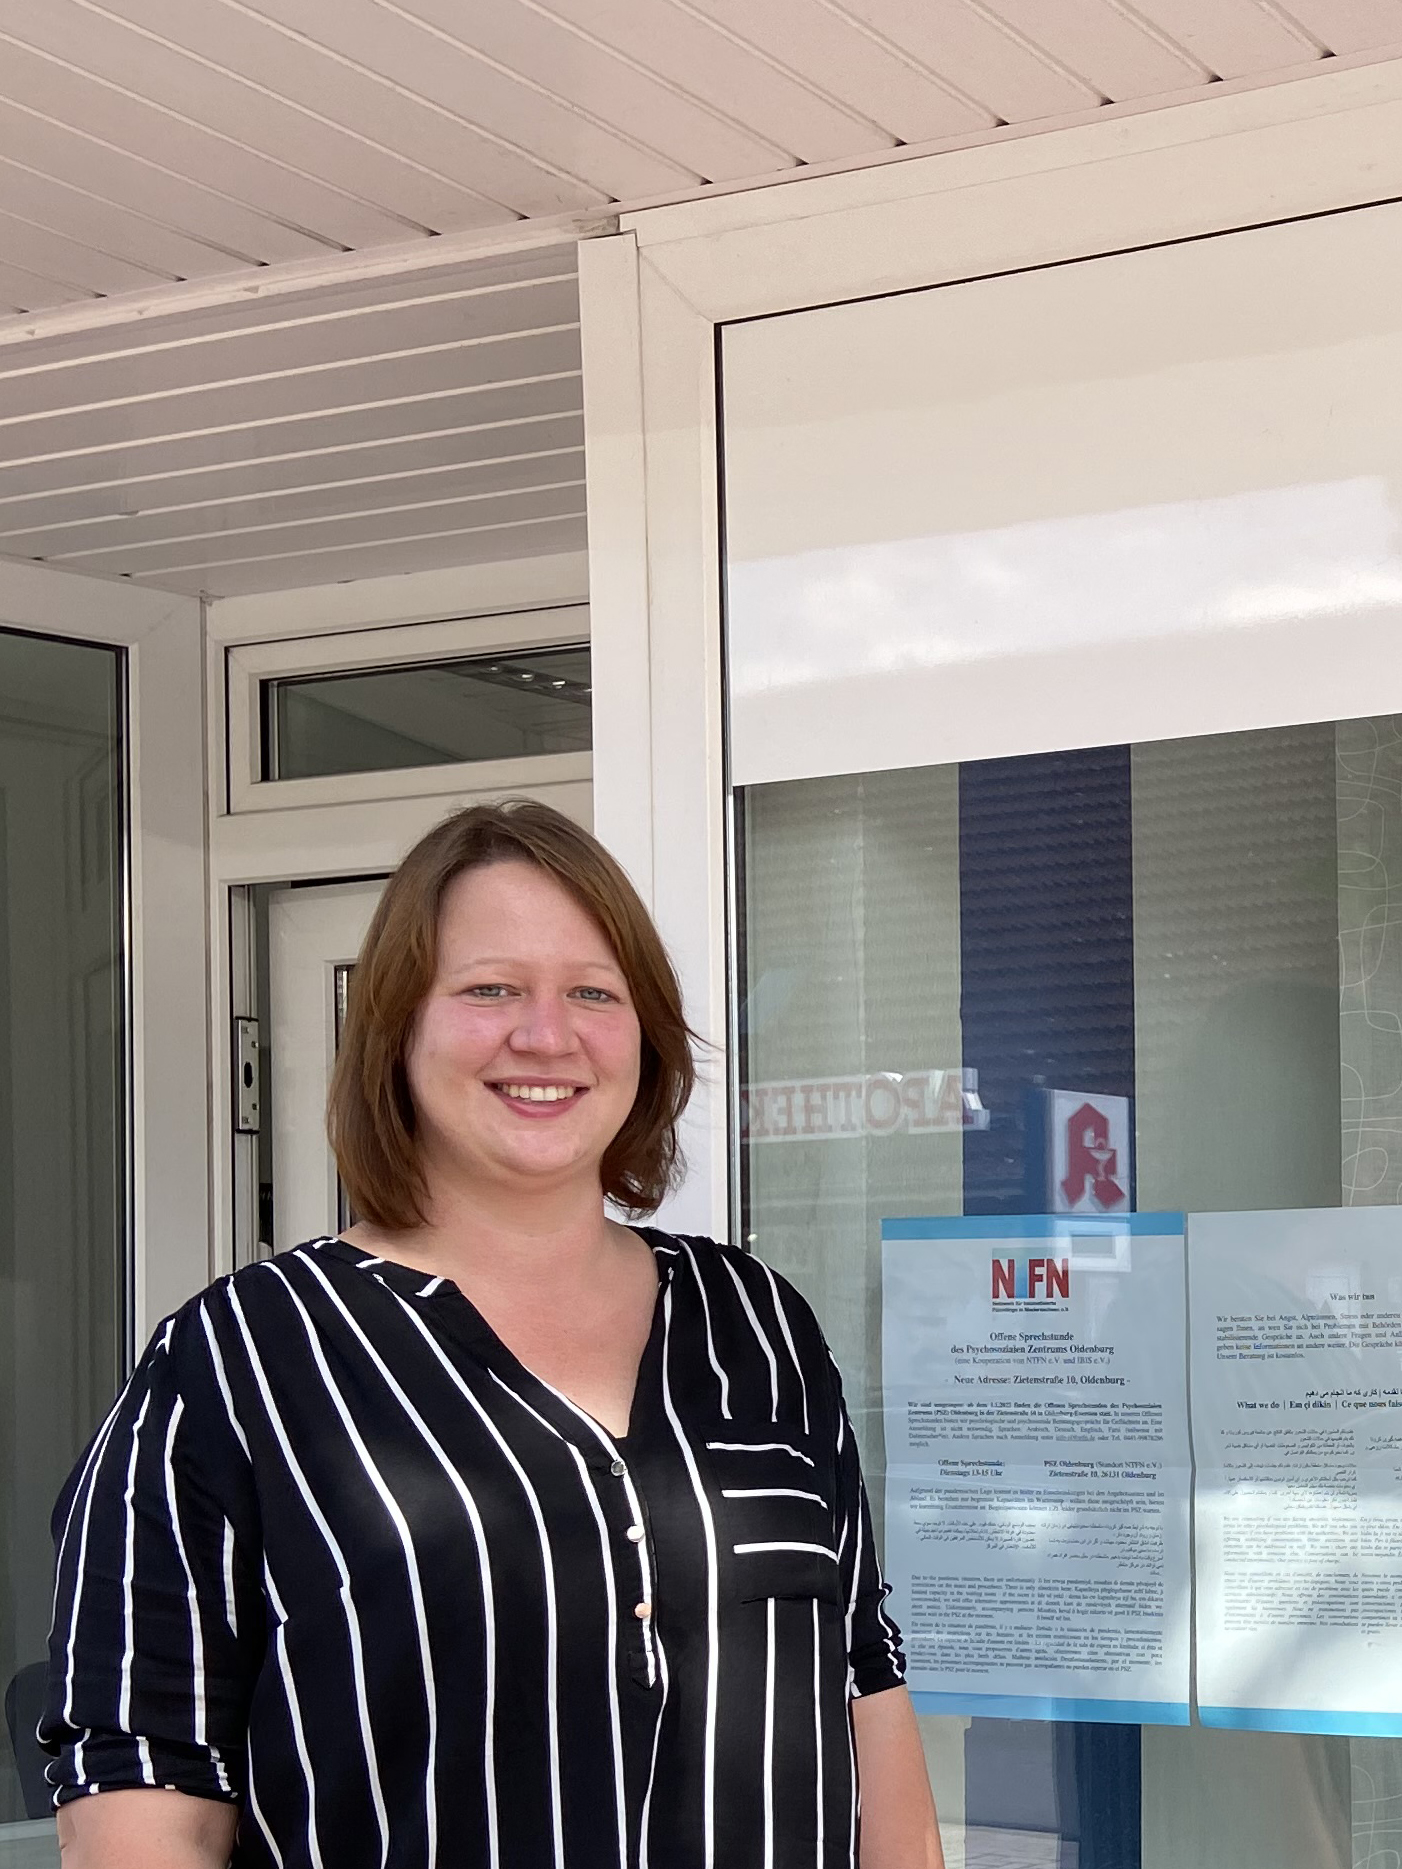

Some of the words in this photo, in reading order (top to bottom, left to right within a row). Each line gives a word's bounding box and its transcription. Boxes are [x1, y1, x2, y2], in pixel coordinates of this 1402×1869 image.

[990, 1332, 1017, 1341] Offene
[1019, 1332, 1074, 1343] Sprechstunde
[951, 1345, 964, 1353] des
[967, 1345, 1025, 1355] Psychosozialen
[1027, 1345, 1067, 1353] Zentrums
[1070, 1344, 1114, 1355] Oldenburg
[954, 1375, 974, 1384] Neue
[977, 1375, 1011, 1384] Adresse:
[1013, 1375, 1064, 1384] Zietenstraße
[1066, 1375, 1078, 1385] 10,
[1081, 1375, 1125, 1386] Oldenburg
[1237, 1400, 1256, 1409] What
[1270, 1401, 1280, 1409] do
[1290, 1400, 1302, 1409] Em
[1341, 1400, 1352, 1408] Ce
[1353, 1401, 1367, 1409] que
[1368, 1400, 1386, 1408] nous
[1059, 1460, 1094, 1469] Oldenburg
[1121, 1471, 1156, 1480] Oldenburg
